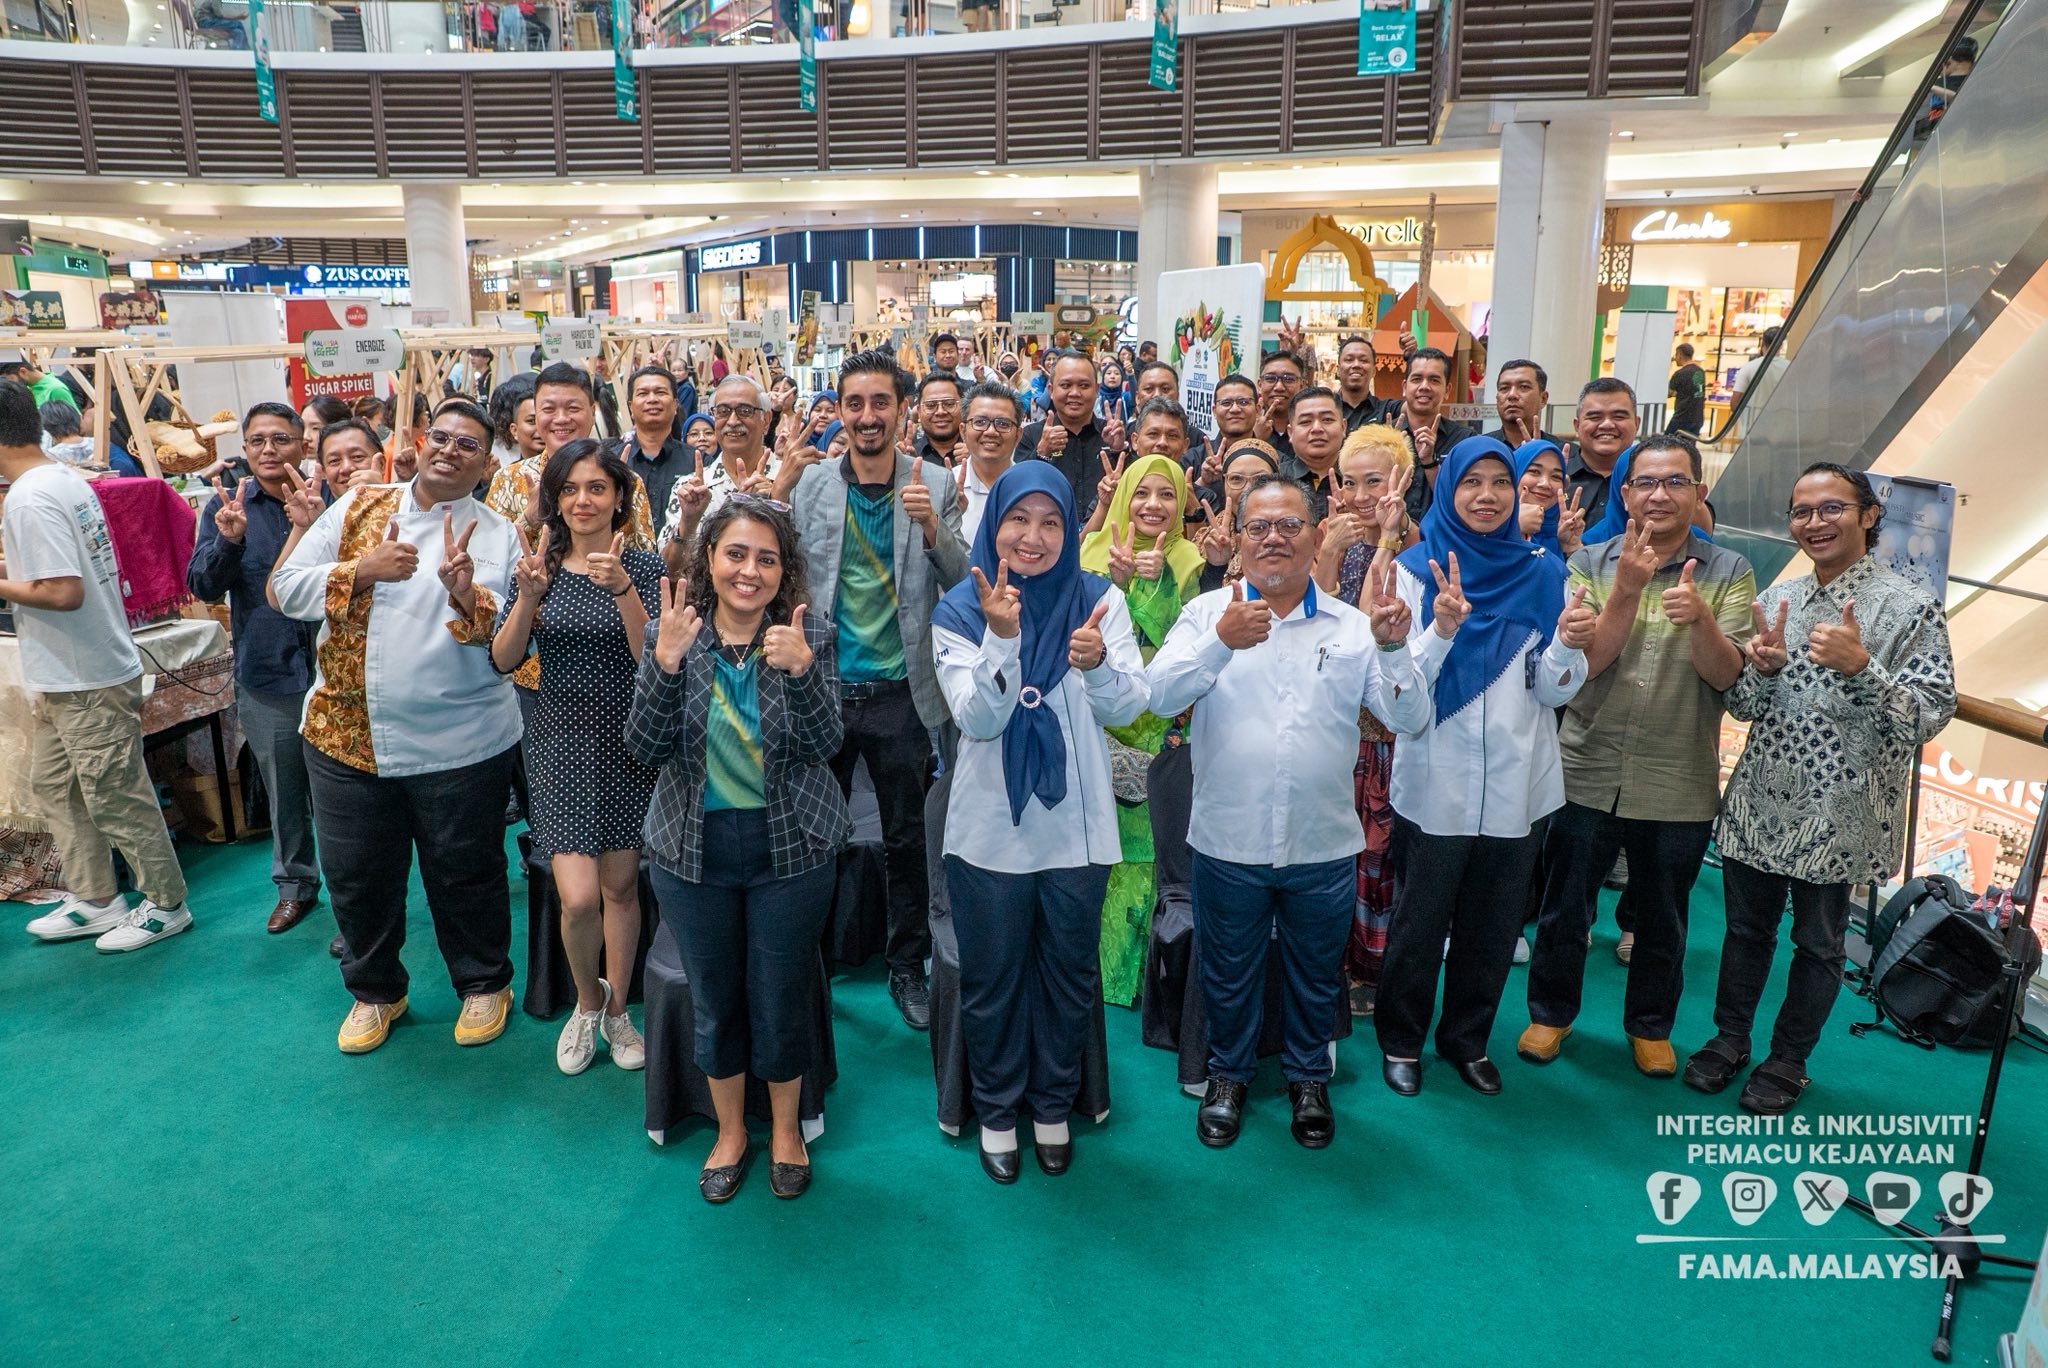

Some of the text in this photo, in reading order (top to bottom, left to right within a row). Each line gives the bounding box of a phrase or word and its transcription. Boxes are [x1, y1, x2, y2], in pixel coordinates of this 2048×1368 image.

[1338, 218, 1426, 243] orell
[1631, 210, 1731, 241] Clarks
[702, 241, 761, 270] SKECHERS
[325, 267, 360, 281] ZUS
[355, 339, 386, 353] ENERGIZE
[304, 378, 373, 397] SUGAR SPIKE!
[1187, 389, 1213, 415] BUAH
[1879, 486, 1893, 498] 4.0
